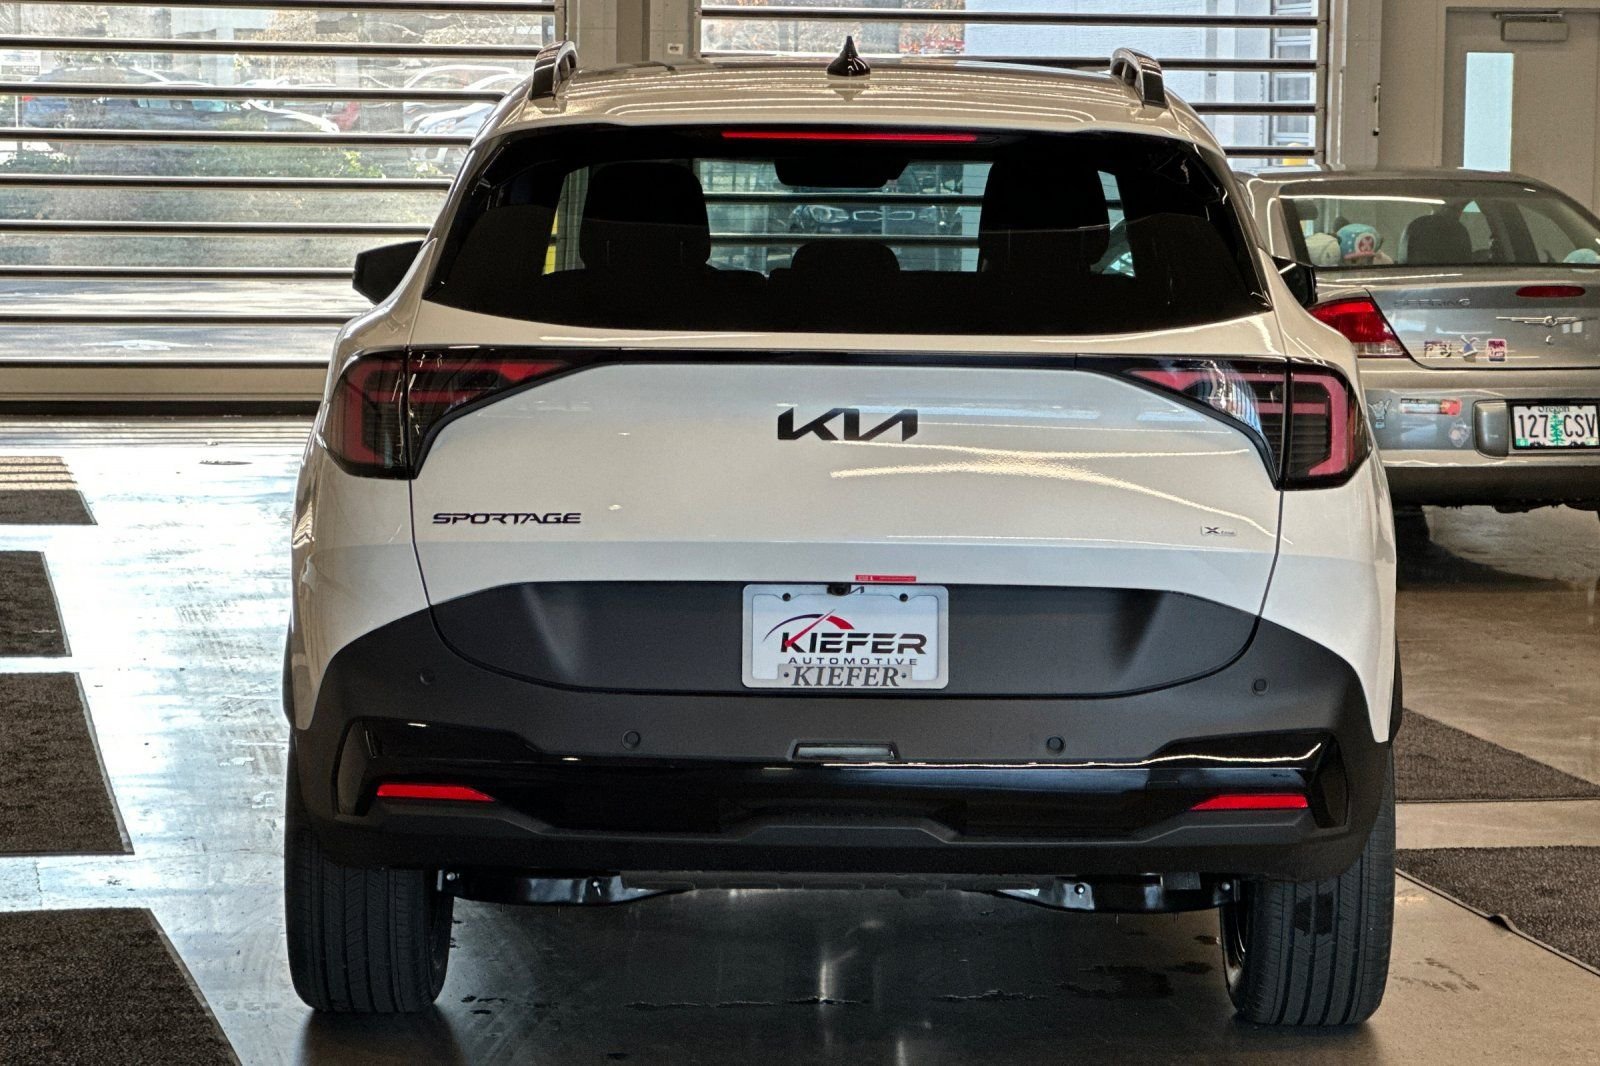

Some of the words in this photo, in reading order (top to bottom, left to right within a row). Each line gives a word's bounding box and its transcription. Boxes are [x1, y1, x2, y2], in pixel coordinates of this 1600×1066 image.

[777, 407, 918, 442] KIA
[1518, 414, 1549, 438] 127
[1563, 413, 1596, 438] CSV
[432, 512, 582, 525] SPORTAGE
[780, 631, 928, 655] KIEFER
[788, 657, 918, 666] AUTOMOTIVE
[791, 666, 900, 687] KIEFER
